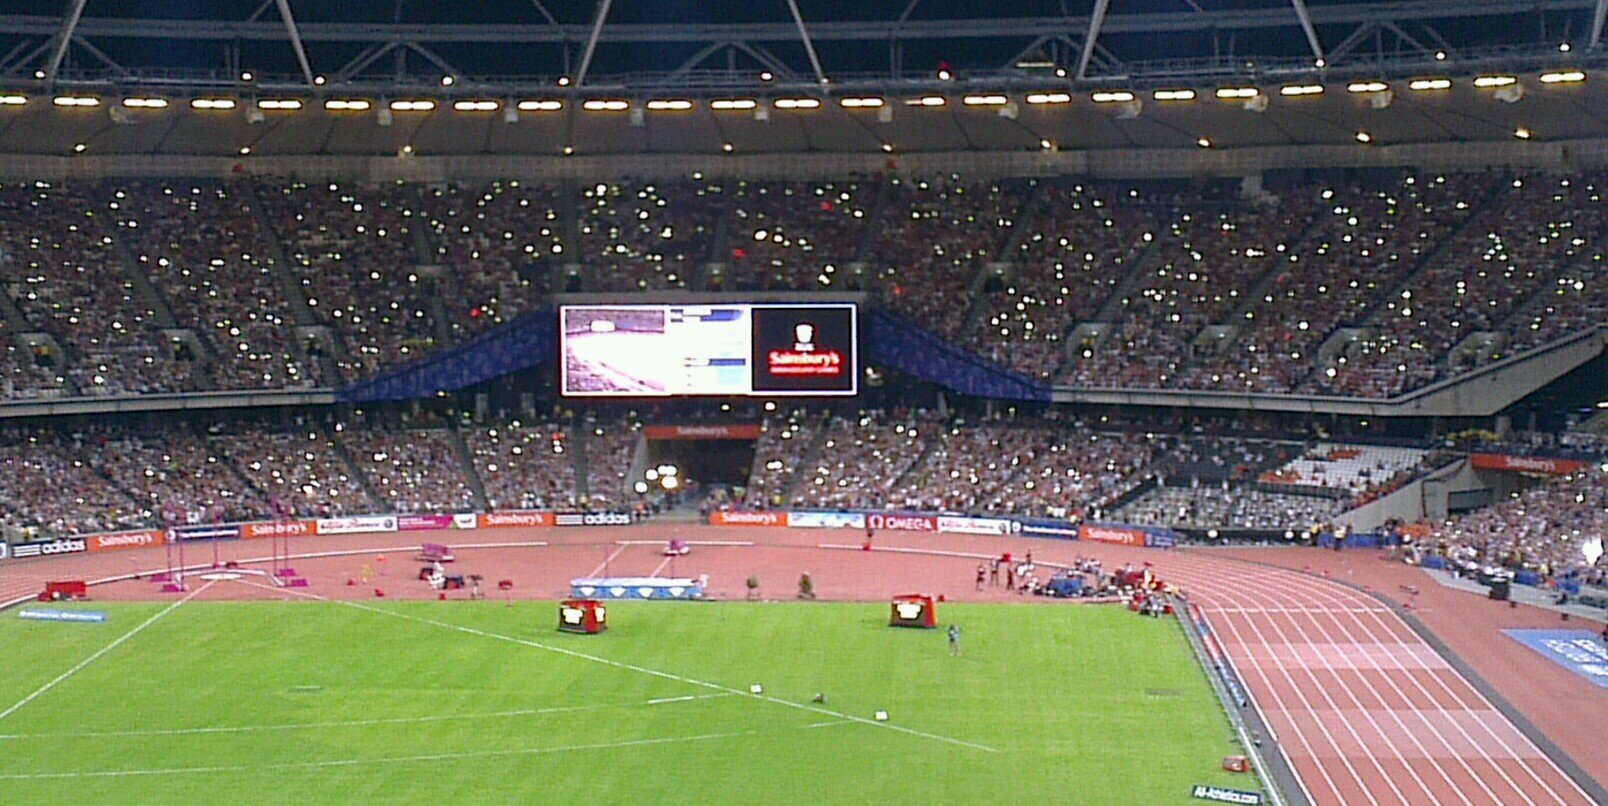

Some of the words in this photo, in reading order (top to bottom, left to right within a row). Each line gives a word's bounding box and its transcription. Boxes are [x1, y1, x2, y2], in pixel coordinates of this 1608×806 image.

[769, 351, 840, 367] Sainsbury's
[486, 512, 543, 525] Sainsbury's
[584, 513, 630, 526] adidas
[721, 512, 777, 525] Sainsbury's
[886, 517, 932, 530] OMEGA
[251, 523, 307, 536] Sainsbury's
[1087, 528, 1135, 544] Sainsbury's
[98, 532, 153, 547] Sainsbury's
[42, 539, 86, 554] adidas
